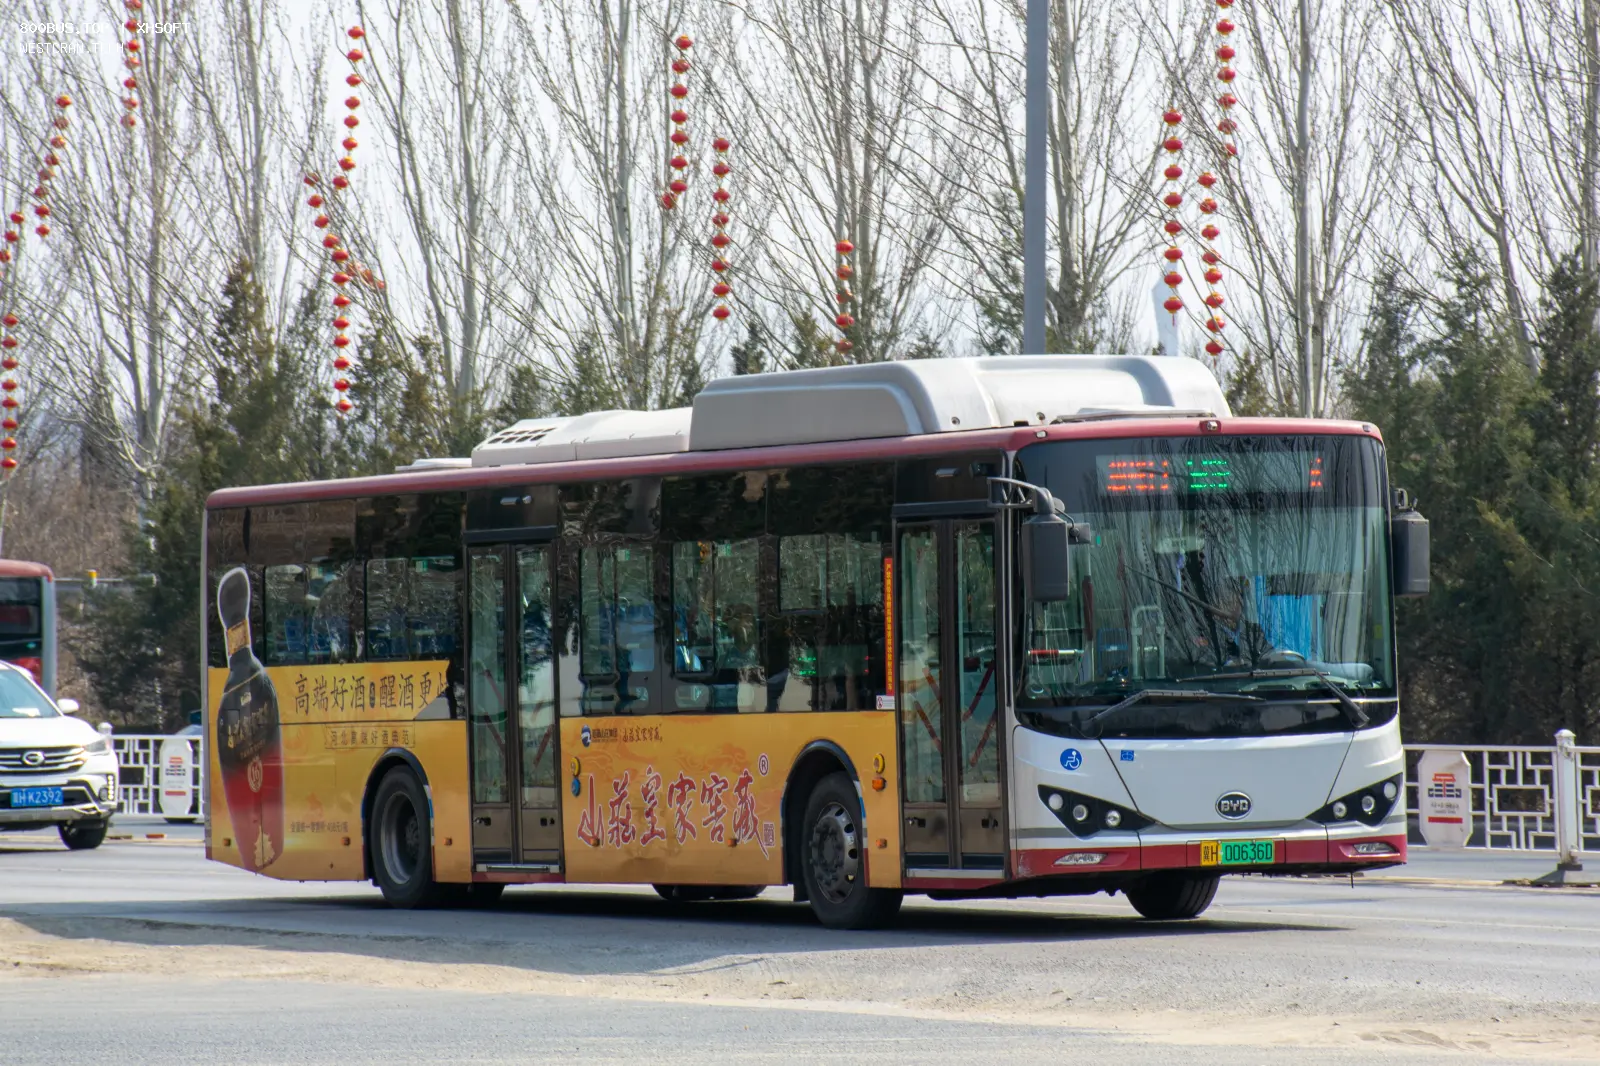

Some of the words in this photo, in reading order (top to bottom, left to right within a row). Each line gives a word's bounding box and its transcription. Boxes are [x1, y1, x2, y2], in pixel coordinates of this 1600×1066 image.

[294, 673, 366, 716] 高端好酒
[1221, 799, 1249, 811] BYD
